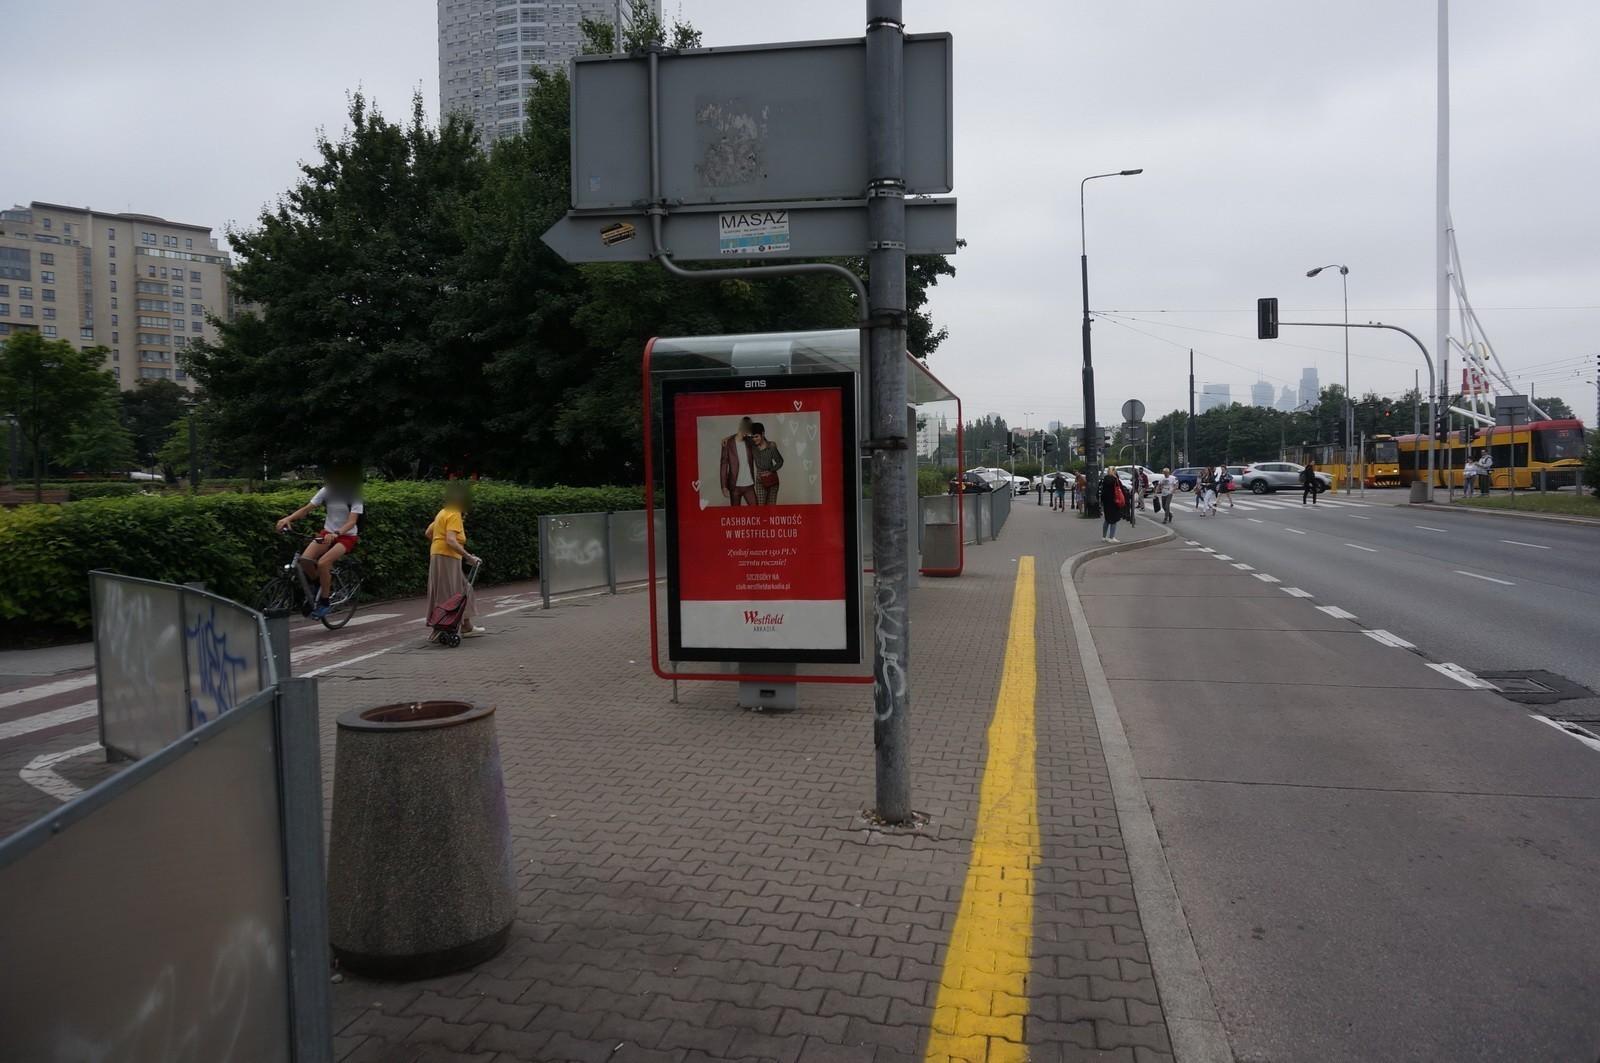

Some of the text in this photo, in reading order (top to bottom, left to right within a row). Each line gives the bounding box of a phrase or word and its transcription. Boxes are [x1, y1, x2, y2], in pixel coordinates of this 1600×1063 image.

[744, 380, 767, 388] ams
[720, 516, 761, 526] CASHBACK
[769, 514, 802, 525] NOWOŚĆ
[725, 528, 797, 539] W WESTFIELD CLUB
[744, 611, 784, 624] Westfield
